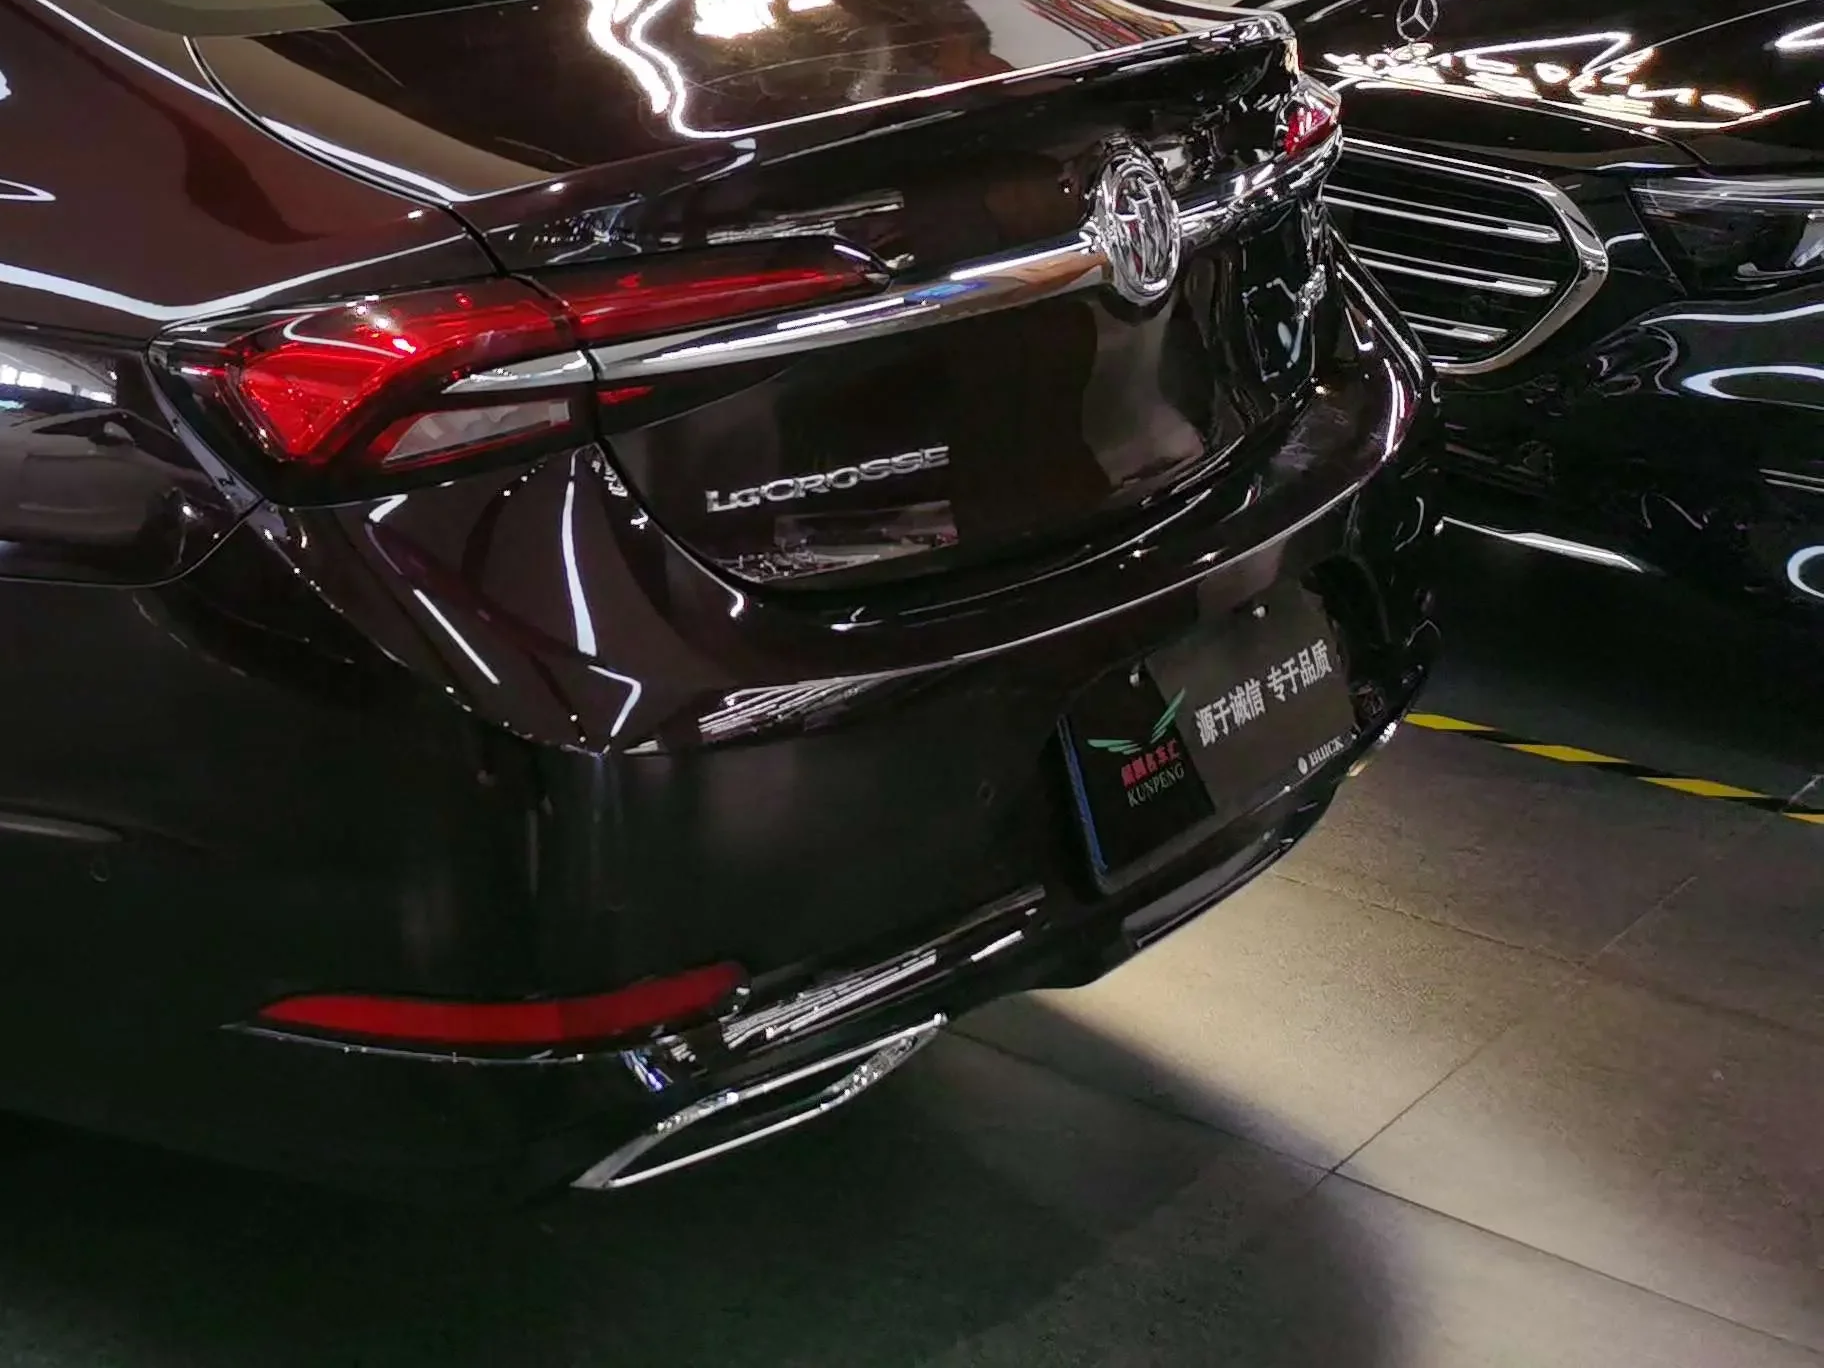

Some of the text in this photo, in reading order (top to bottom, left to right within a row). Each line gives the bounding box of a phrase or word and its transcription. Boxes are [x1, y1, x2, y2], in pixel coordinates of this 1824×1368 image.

[1194, 638, 1333, 748] 源于诚信 专于品质
[1308, 735, 1344, 767] BUICK
[1127, 761, 1185, 808] KUNPENG
